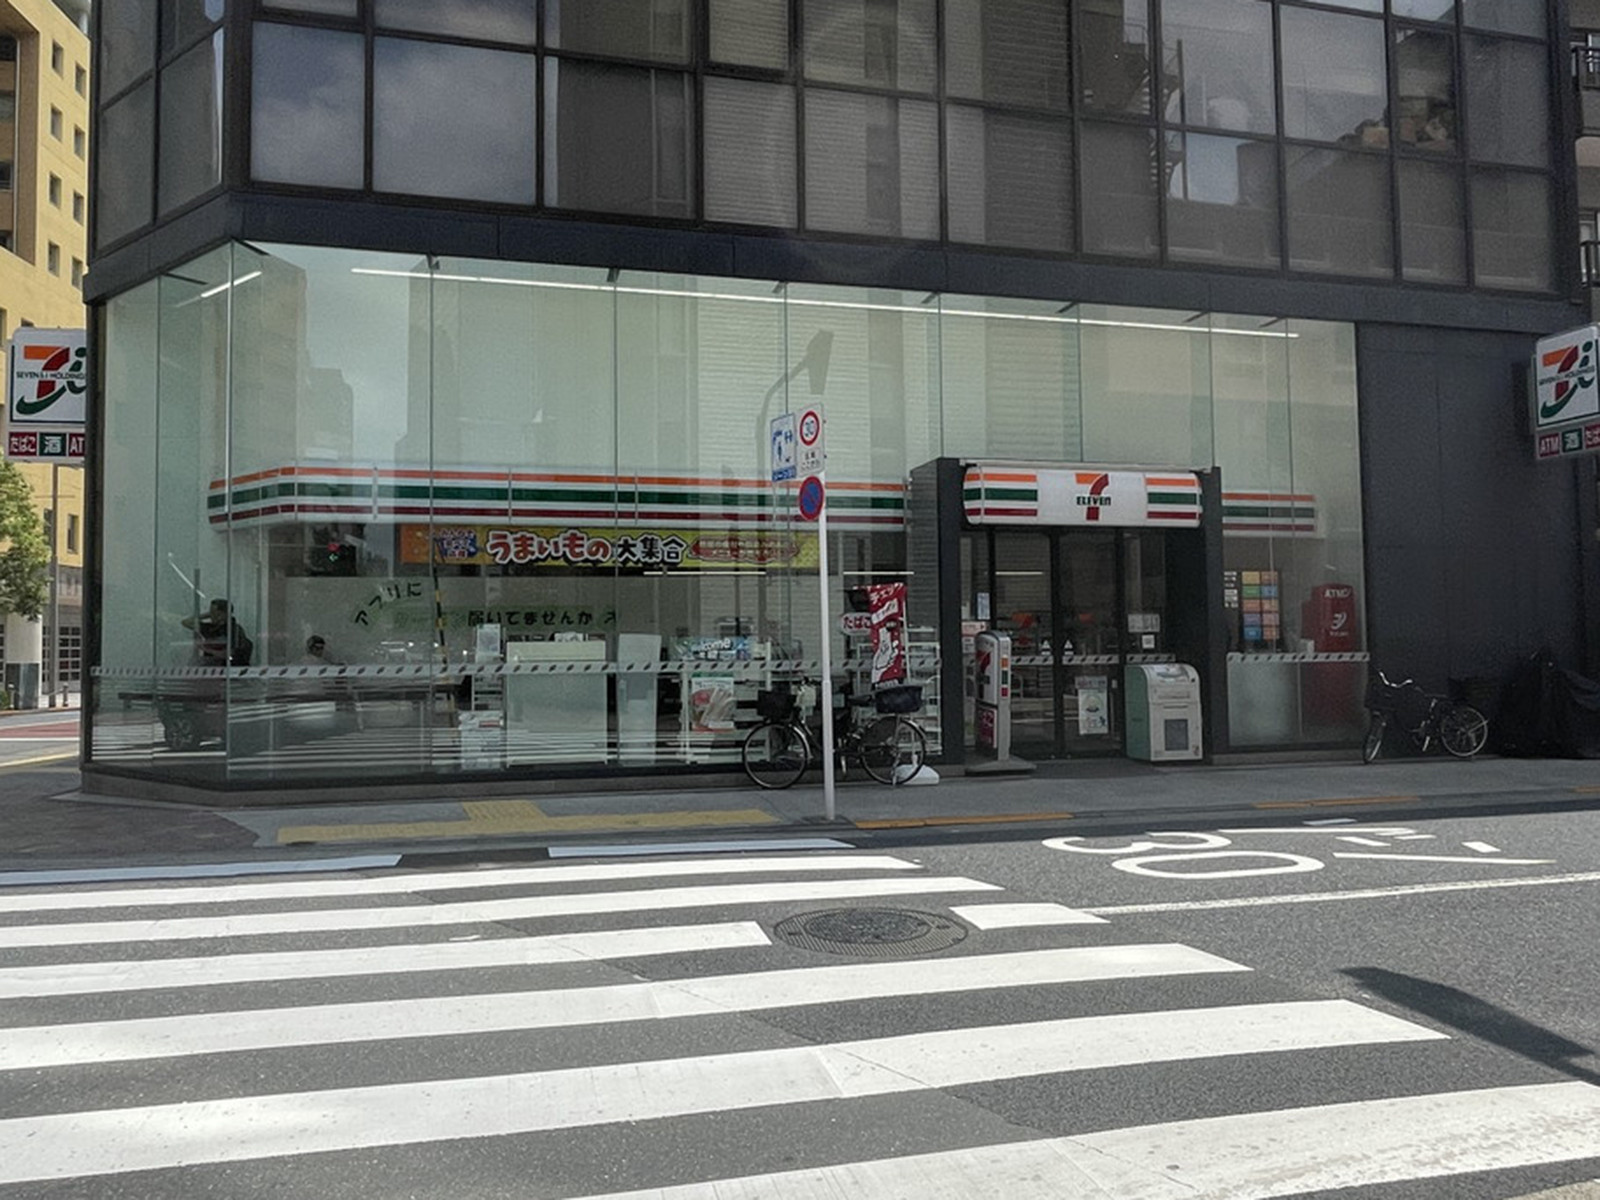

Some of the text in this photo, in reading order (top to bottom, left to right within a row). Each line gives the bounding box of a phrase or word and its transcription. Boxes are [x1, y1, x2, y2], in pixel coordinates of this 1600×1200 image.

[10, 437, 37, 452] たばこ
[44, 437, 62, 453] 酒
[487, 528, 687, 564] うまいもの大集合
